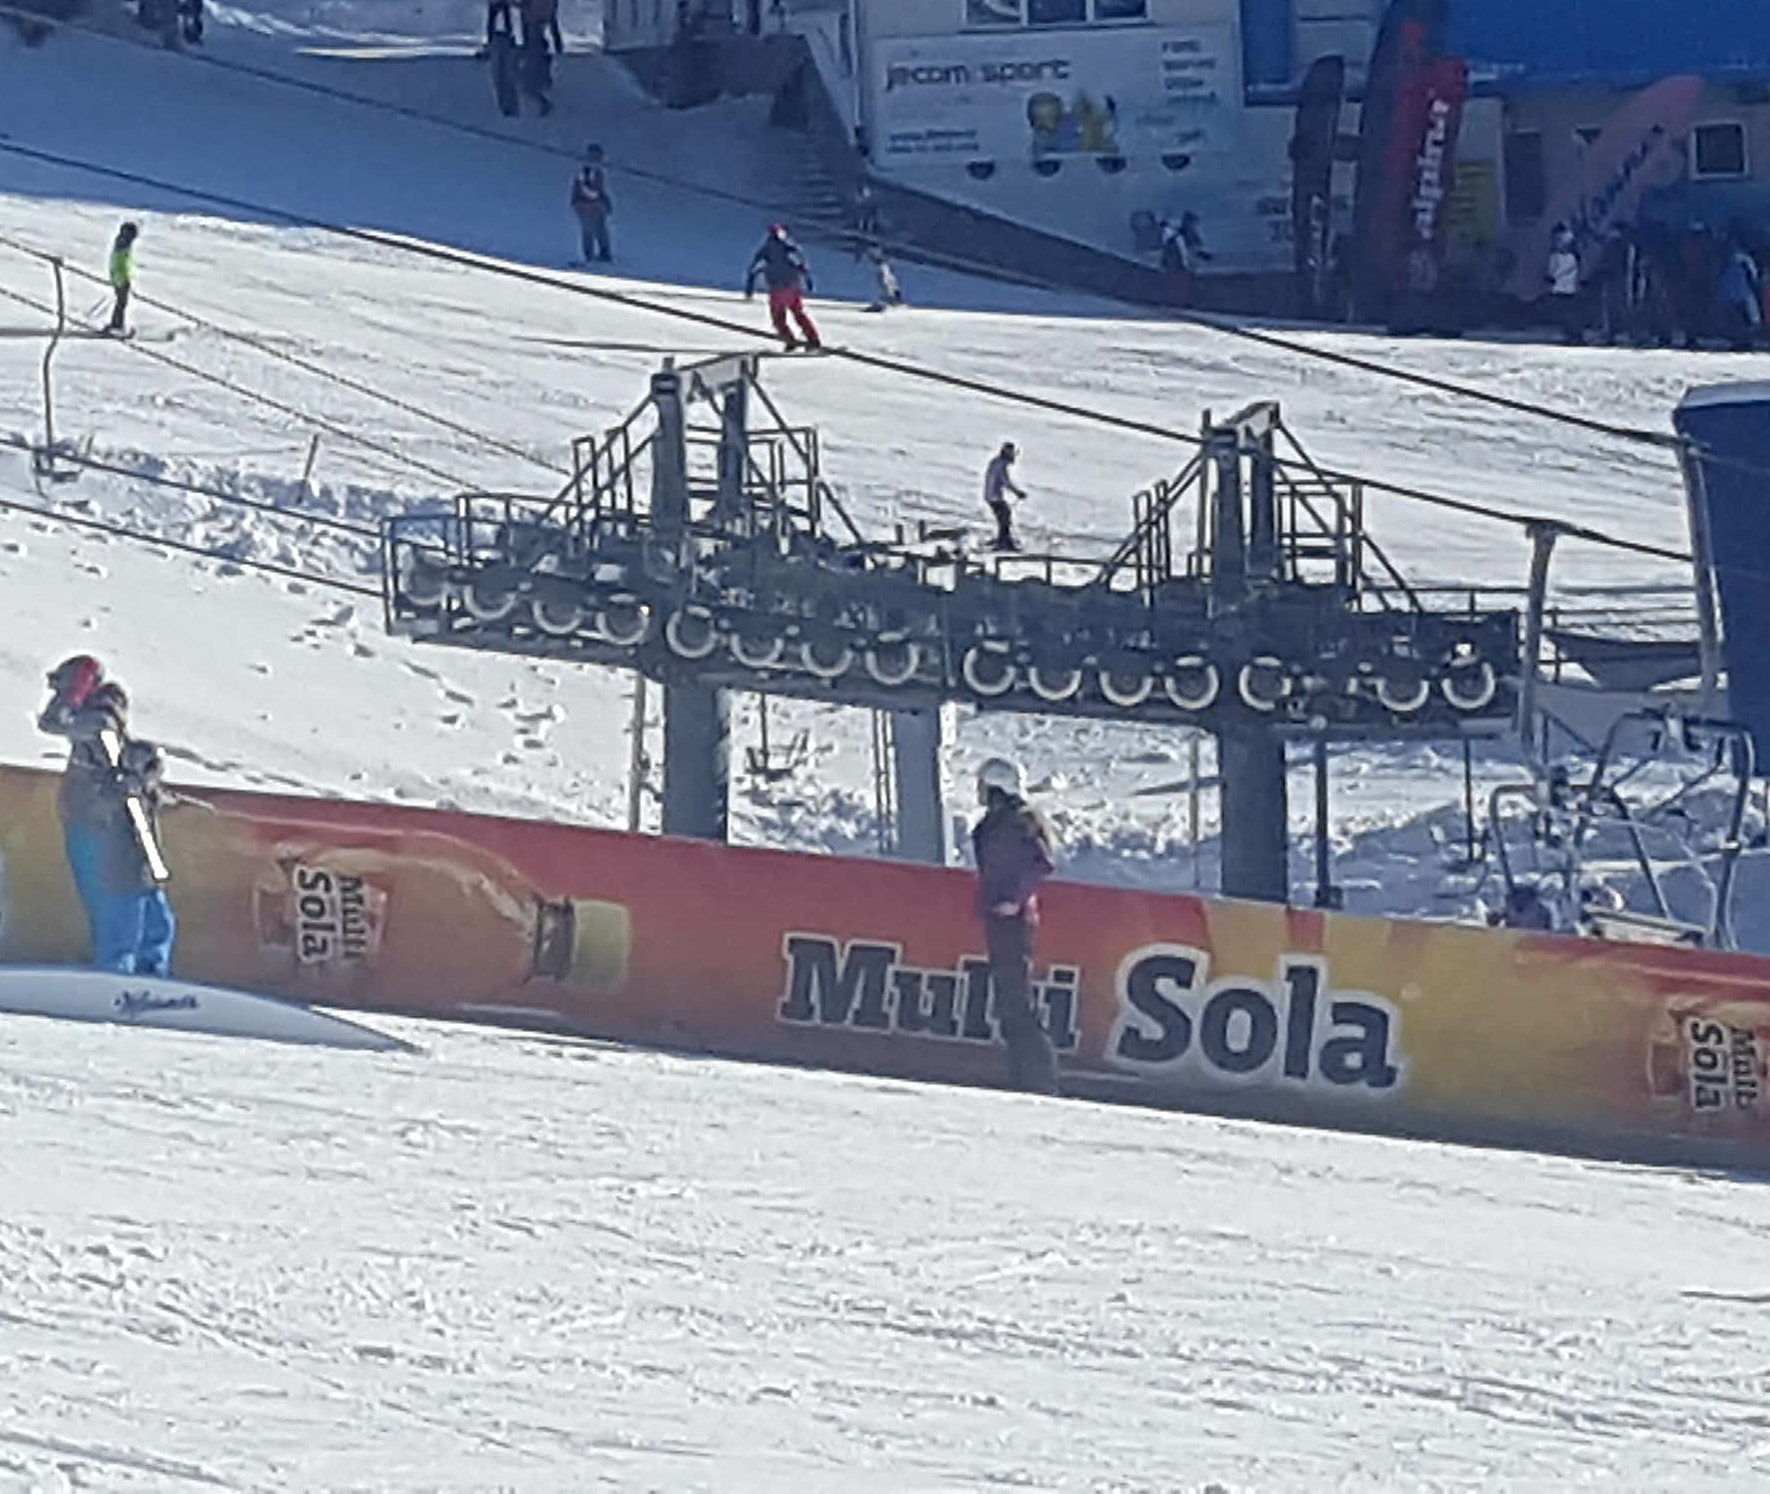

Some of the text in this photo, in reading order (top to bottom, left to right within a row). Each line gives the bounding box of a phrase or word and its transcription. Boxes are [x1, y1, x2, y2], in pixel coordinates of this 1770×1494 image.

[297, 868, 337, 958] Sola
[779, 936, 1400, 1090] Muli Sola
[1690, 1021, 1728, 1109] Sola
